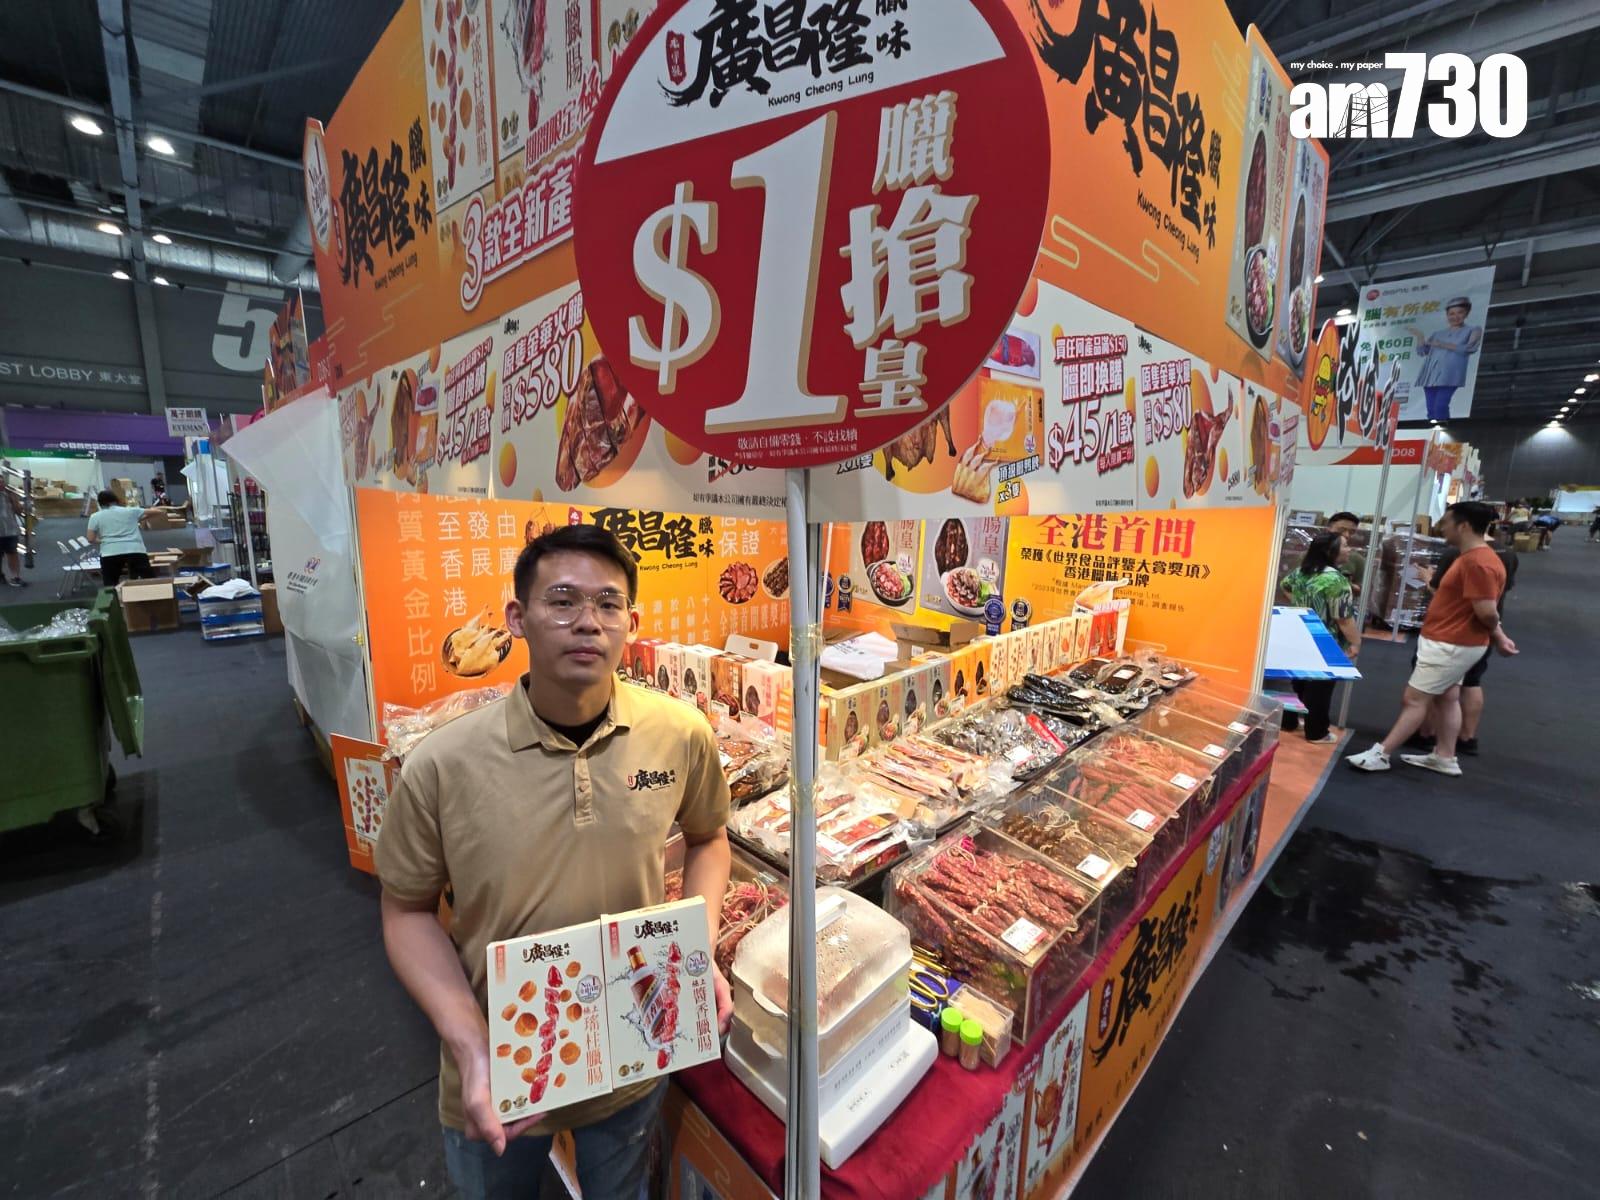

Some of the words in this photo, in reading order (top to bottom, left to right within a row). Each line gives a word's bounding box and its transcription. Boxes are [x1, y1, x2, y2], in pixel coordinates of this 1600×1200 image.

[658, 0, 873, 108] 廣昌隆
[768, 91, 801, 108] Kwong
[805, 79, 843, 97] Cheong
[848, 72, 874, 88] Lung
[1137, 188, 1162, 230] Kwong
[1163, 212, 1188, 247] Cheong
[1186, 235, 1201, 264] Lung
[627, 110, 850, 436] $1
[211, 281, 286, 372] 5
[502, 290, 584, 381] 原隻金華火腿
[31, 365, 93, 382] LOBBY
[513, 329, 585, 423] $580
[1153, 384, 1192, 441] $580
[662, 561, 683, 570] Cheong
[698, 516, 715, 559] 臘味
[1038, 513, 1196, 560] 全港首間
